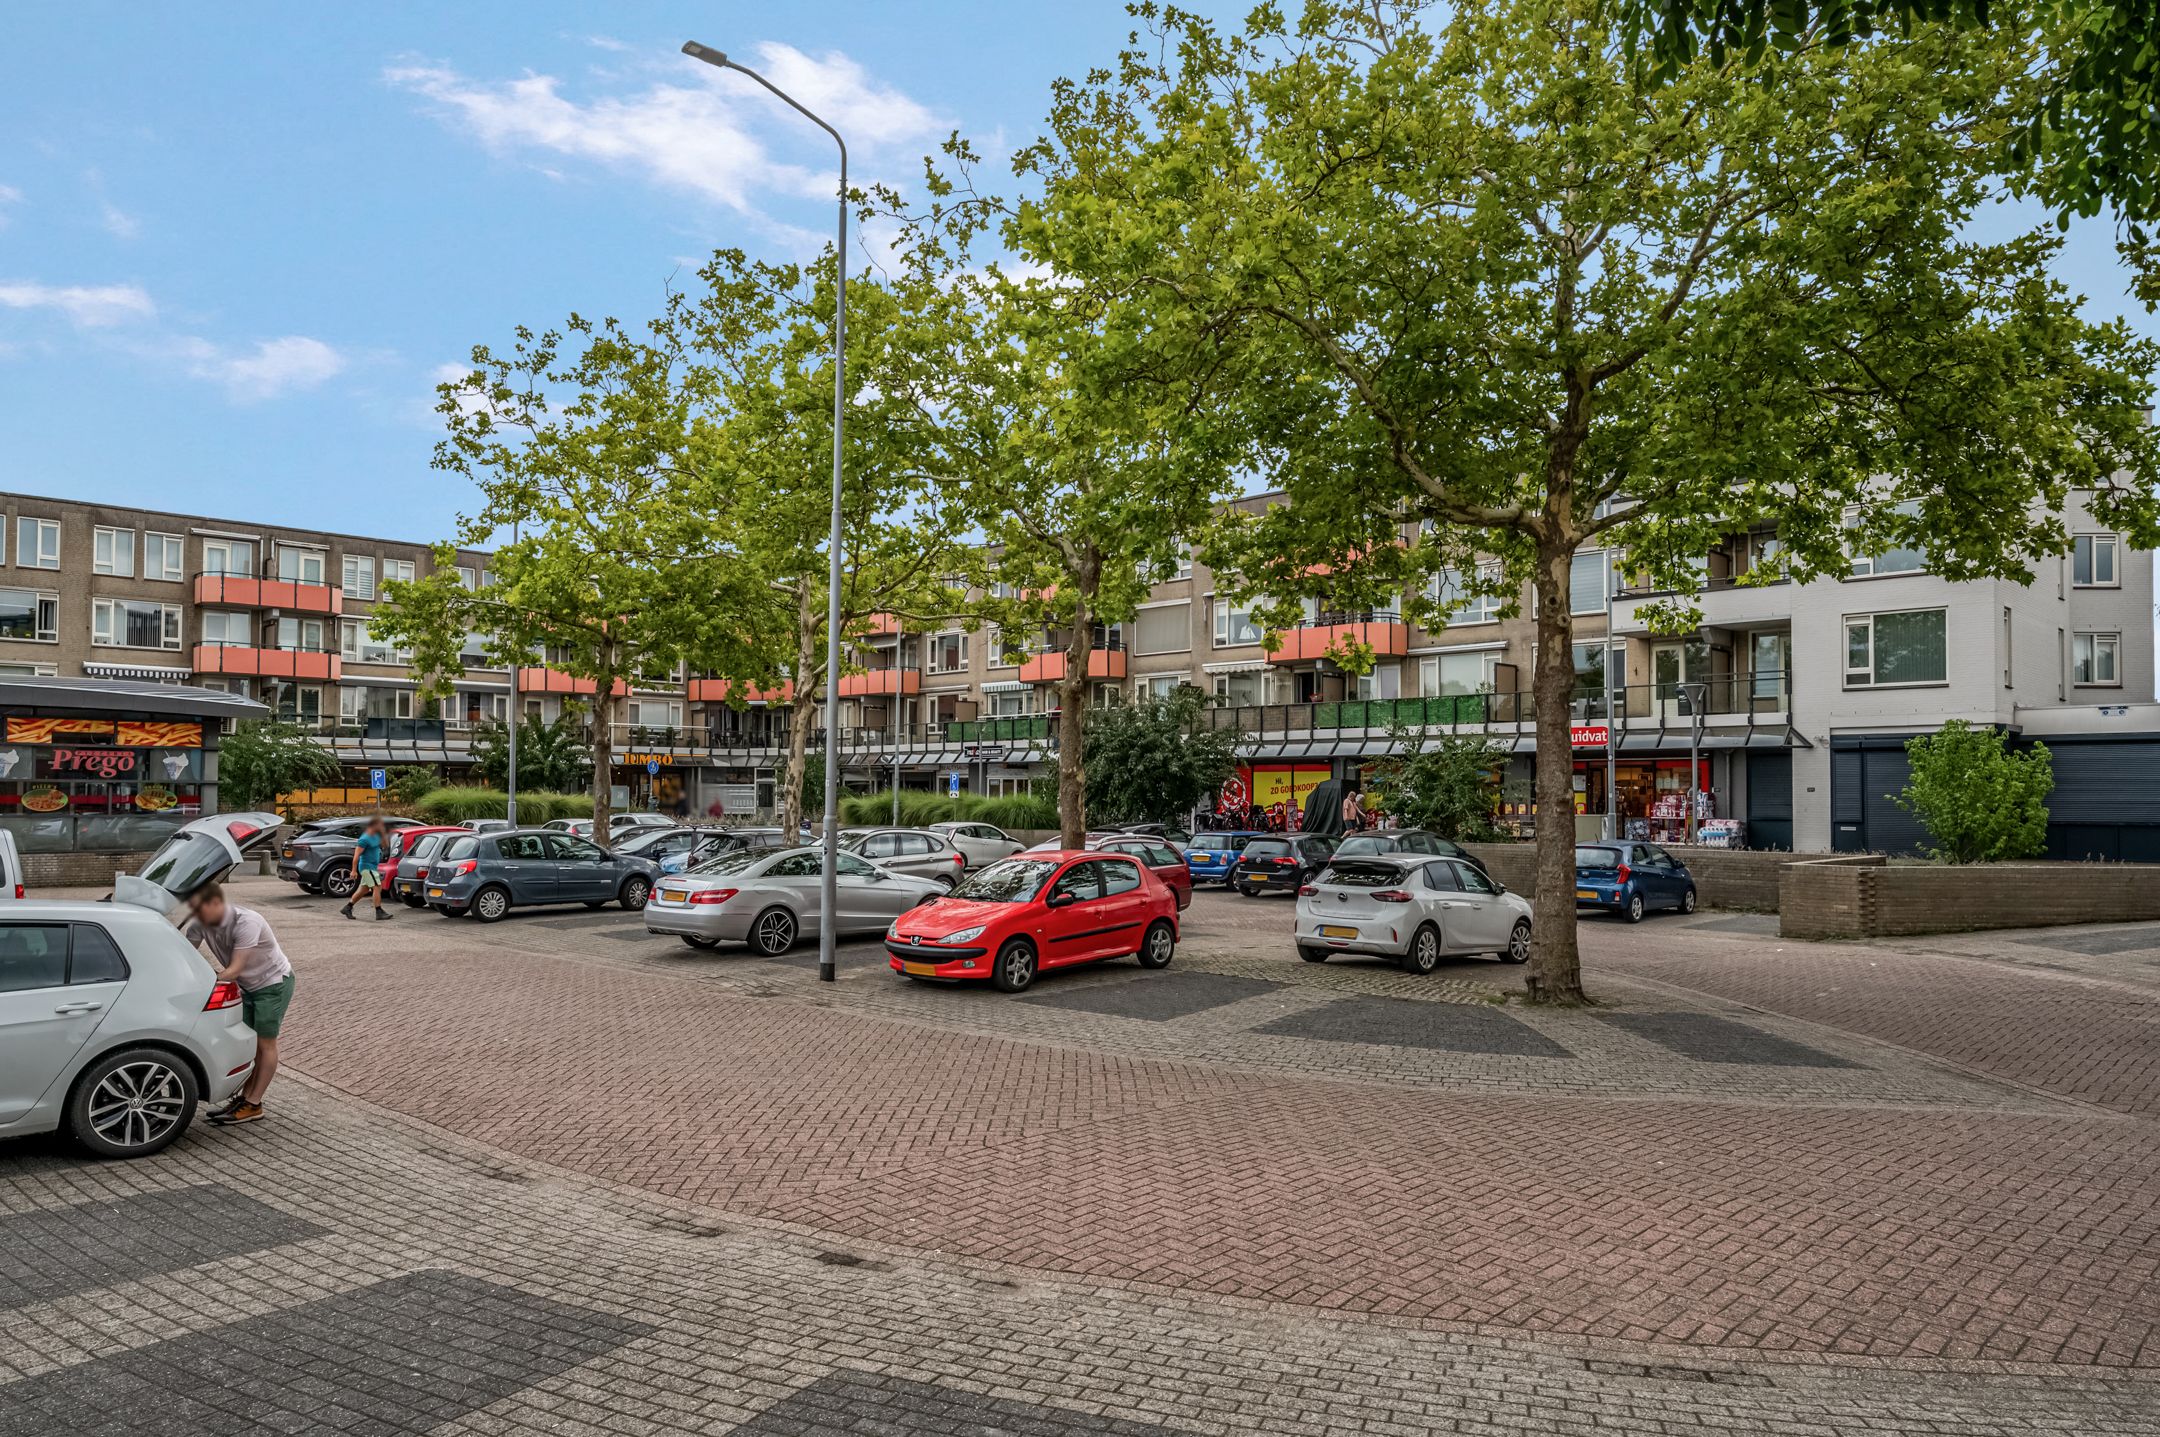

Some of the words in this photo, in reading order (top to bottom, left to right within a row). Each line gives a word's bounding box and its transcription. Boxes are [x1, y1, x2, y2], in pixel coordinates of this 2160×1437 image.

[1571, 730, 1608, 742] uidvat
[50, 749, 135, 778] Prego
[623, 752, 673, 766] JUMBO
[374, 771, 383, 781] P
[1270, 786, 1279, 795] ZO
